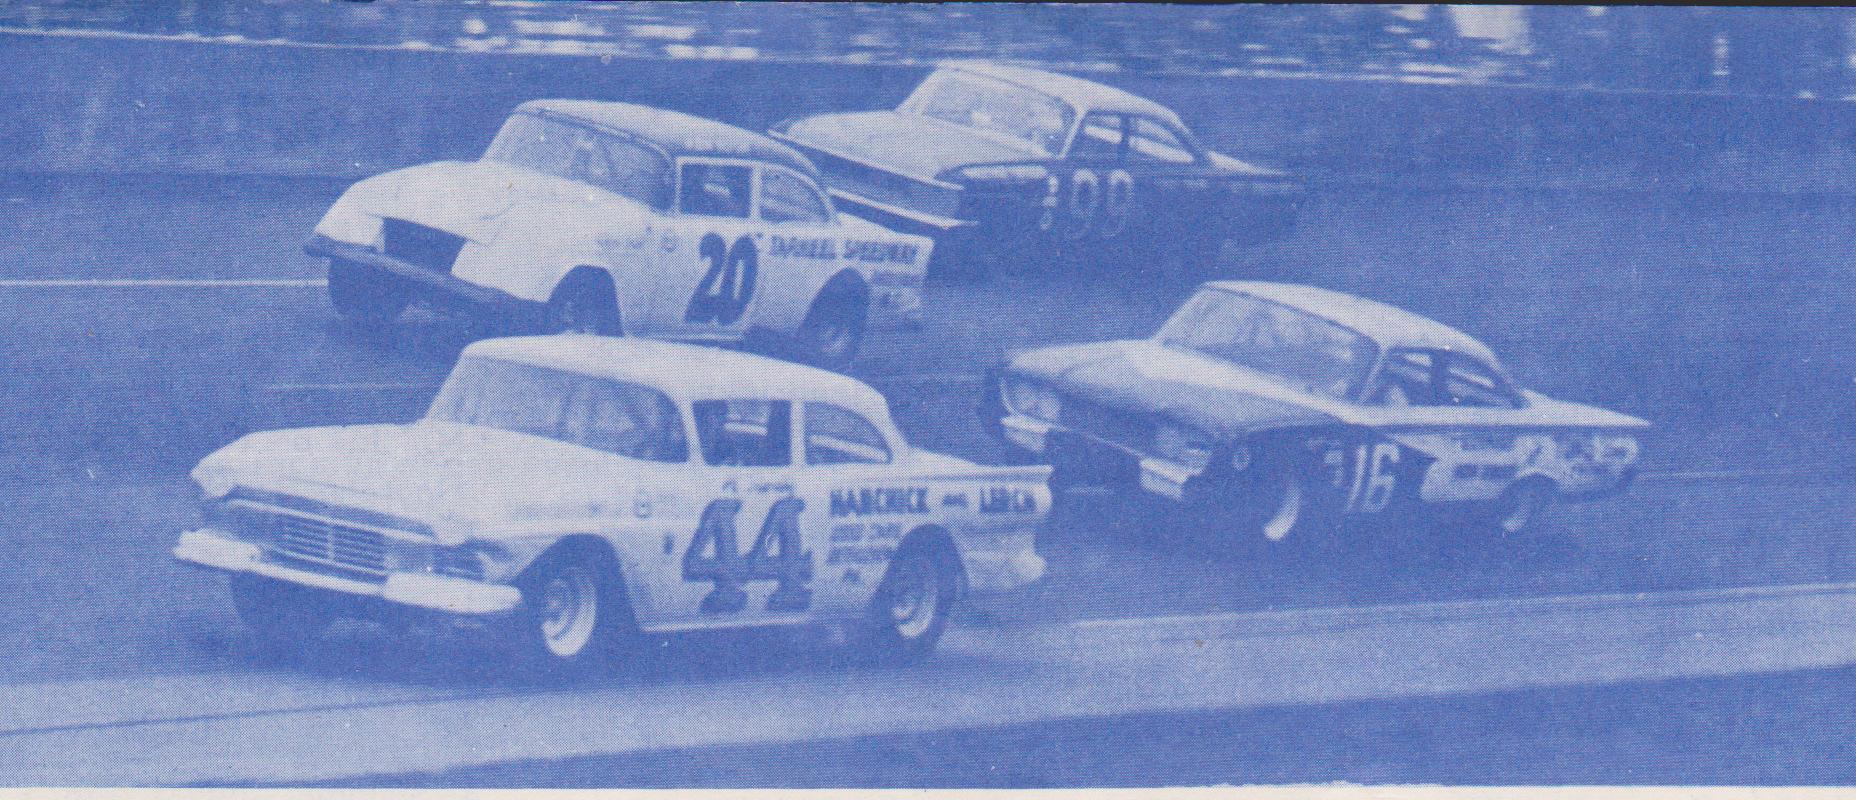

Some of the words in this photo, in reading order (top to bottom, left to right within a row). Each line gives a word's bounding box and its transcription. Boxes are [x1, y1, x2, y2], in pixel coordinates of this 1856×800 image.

[1064, 168, 1135, 240] 99
[685, 231, 758, 326] 20
[843, 238, 920, 264] SPEEDWAY
[1344, 443, 1400, 513] 16
[682, 497, 814, 614] 44
